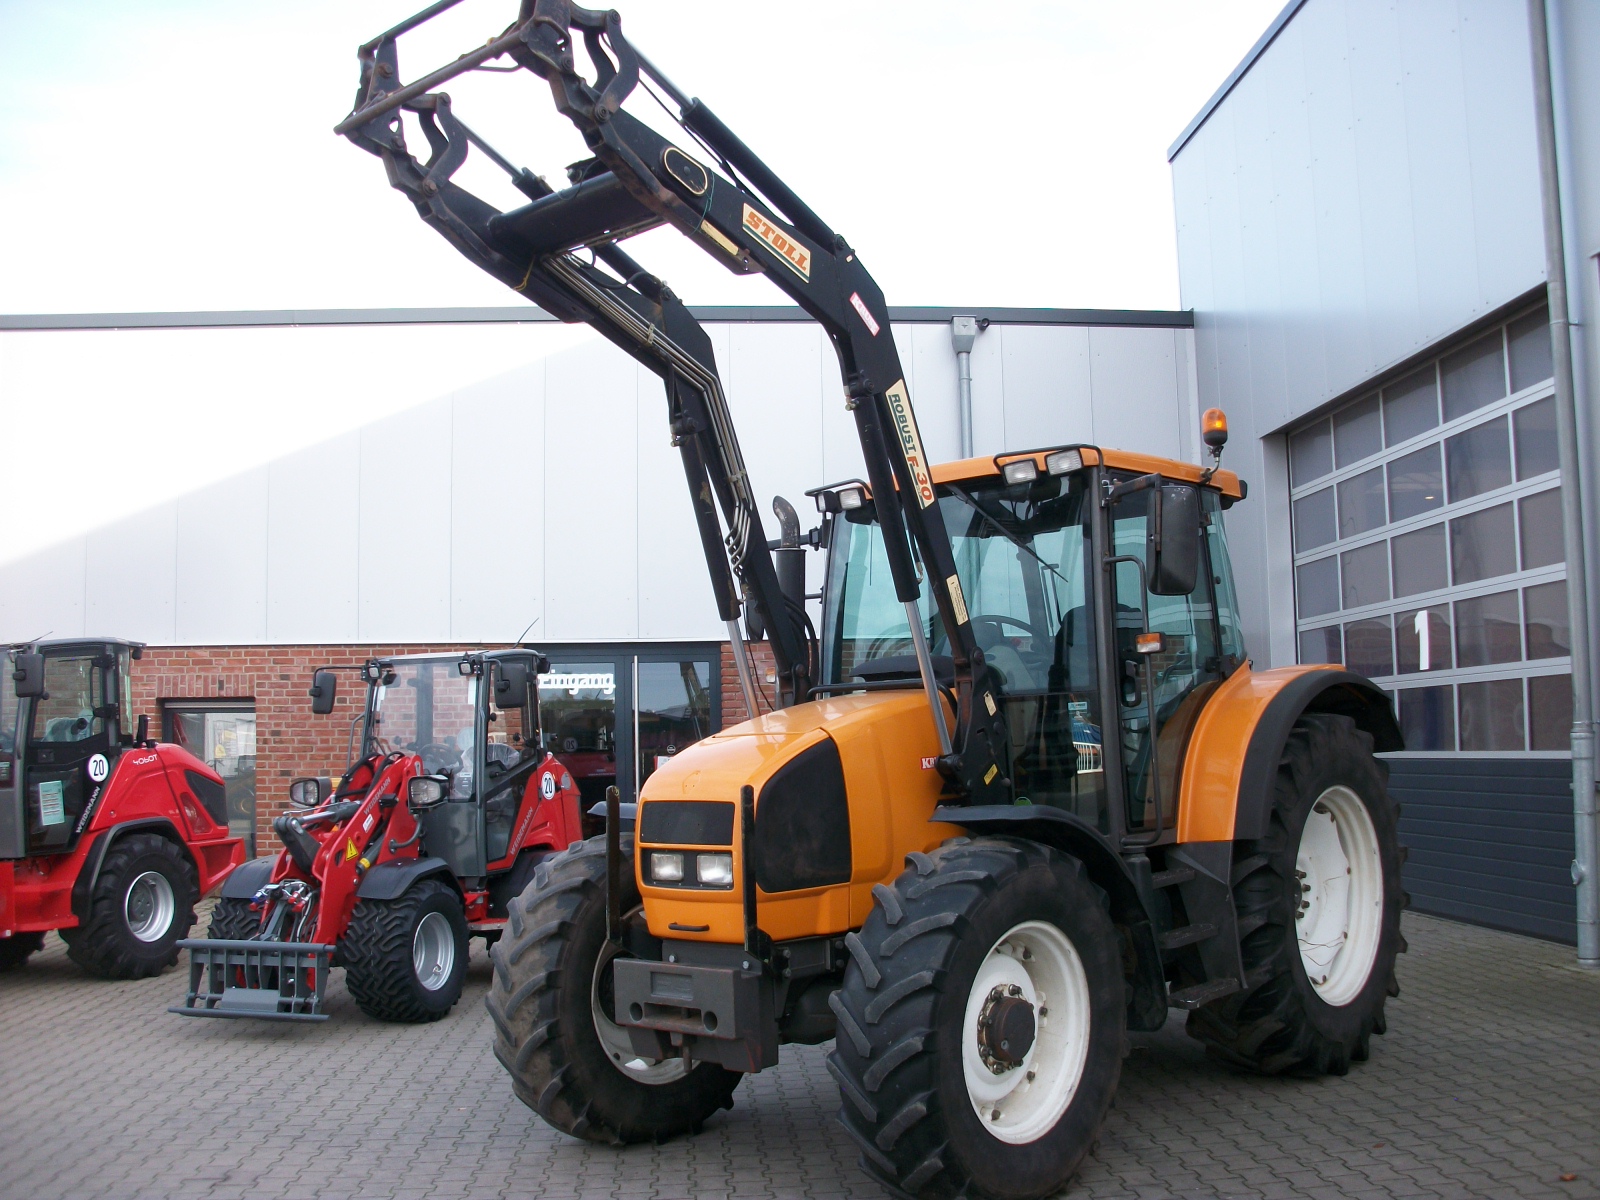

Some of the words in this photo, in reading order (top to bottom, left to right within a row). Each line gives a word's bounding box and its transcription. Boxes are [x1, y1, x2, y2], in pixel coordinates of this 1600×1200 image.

[746, 211, 808, 271] STOLL
[891, 393, 917, 453] ROBUST
[907, 455, 920, 468] F
[916, 472, 933, 501] 30
[1414, 609, 1429, 671] 1
[537, 669, 616, 695] Eingang
[92, 759, 105, 777] 20
[544, 777, 553, 795] 20
[76, 785, 101, 833] WEIDEMANN
[364, 776, 391, 815] WEIDEMANN
[510, 806, 533, 855] WEIDEMANN
